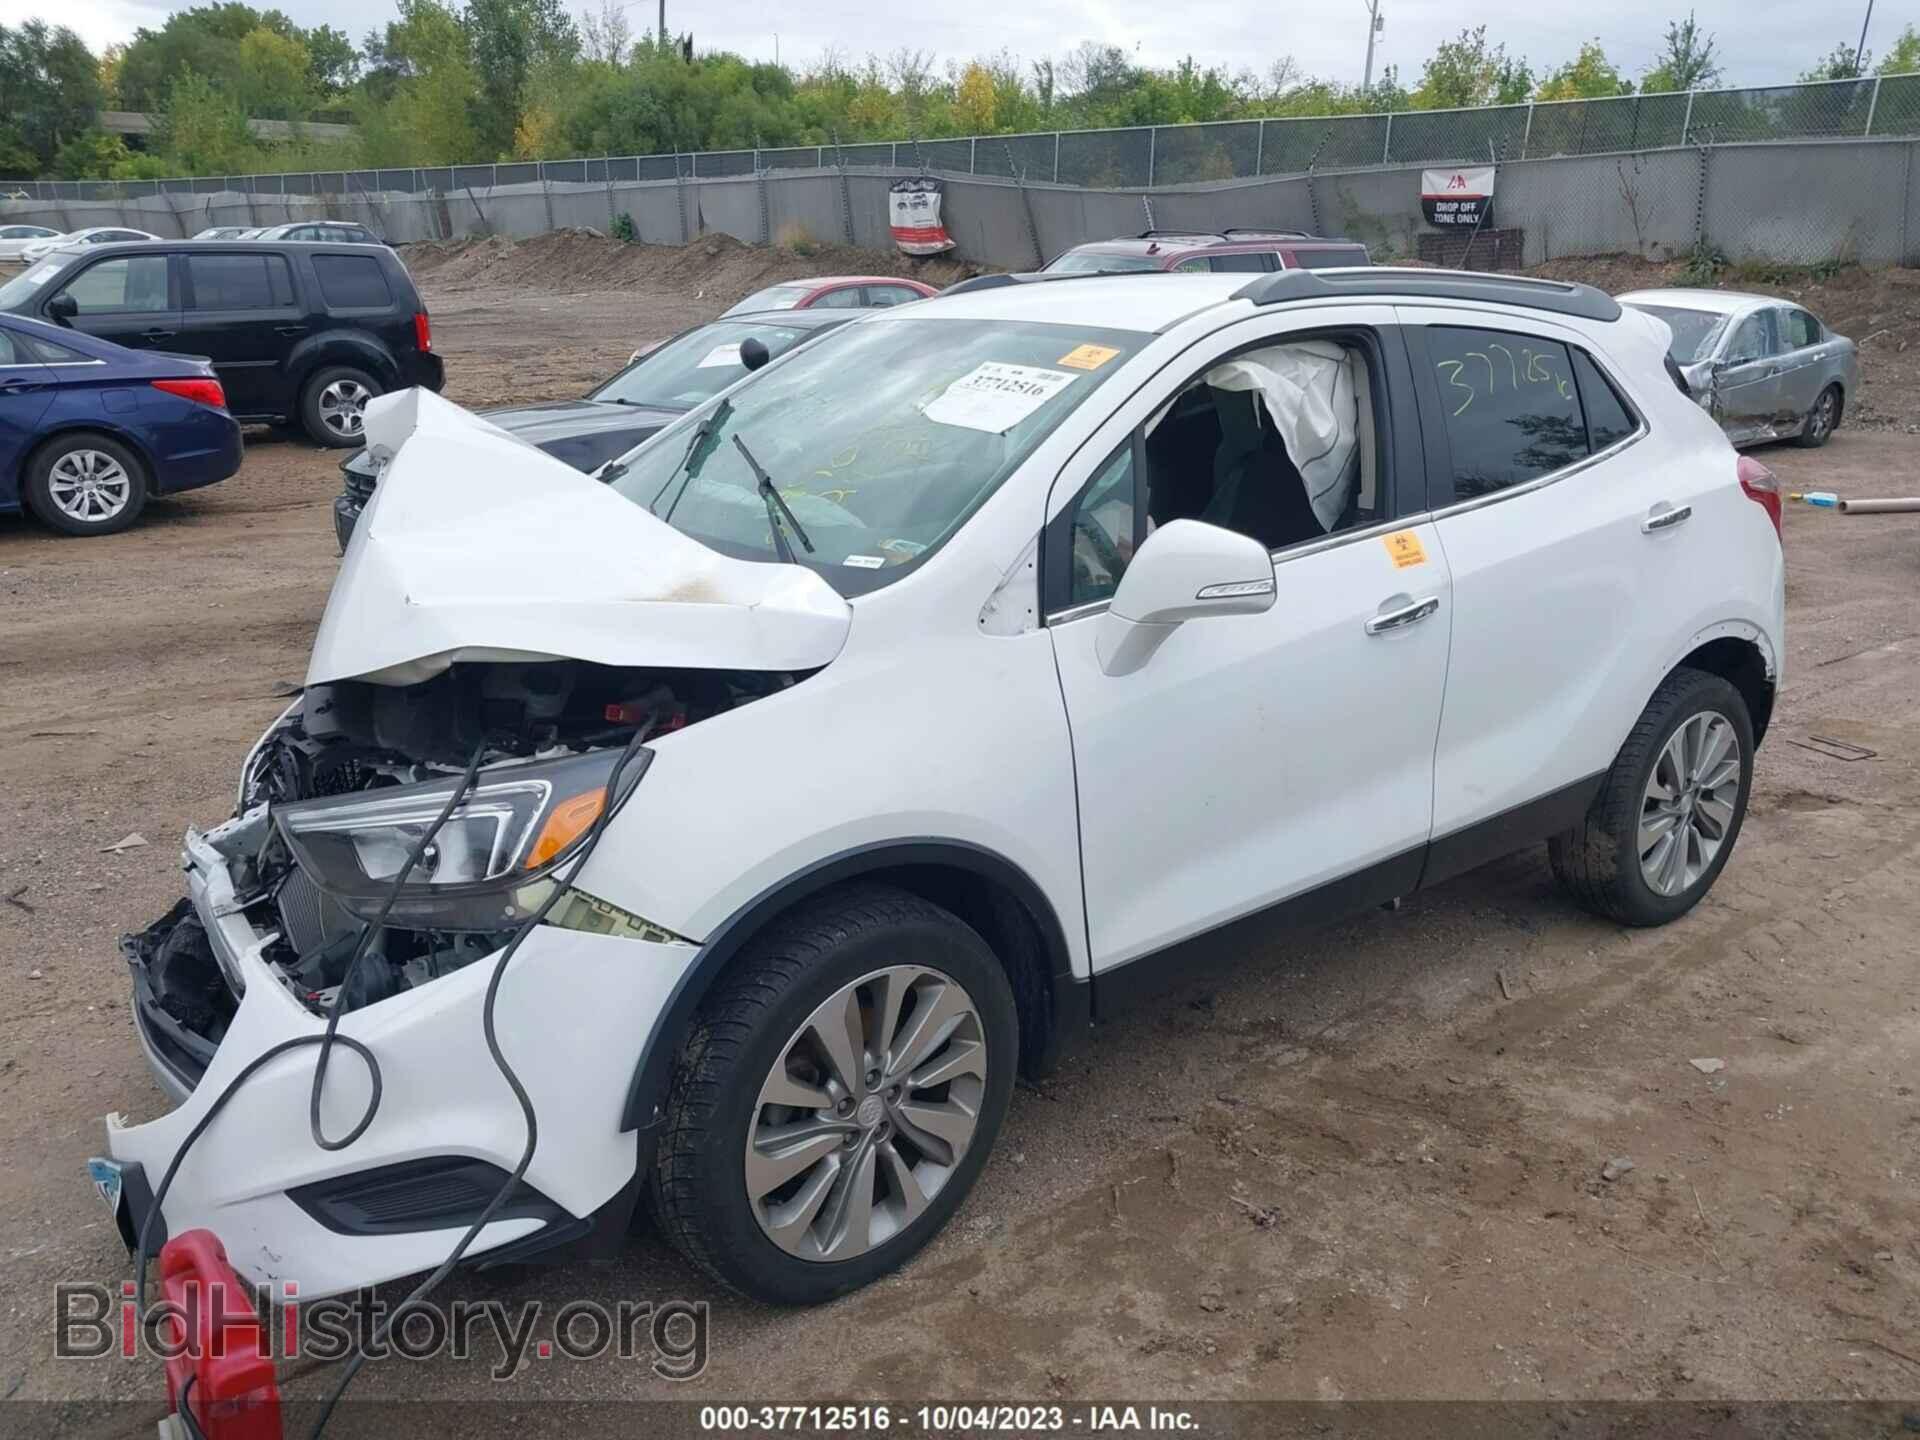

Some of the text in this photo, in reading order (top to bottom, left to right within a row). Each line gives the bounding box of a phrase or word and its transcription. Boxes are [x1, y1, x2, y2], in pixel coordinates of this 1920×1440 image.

[1436, 202, 1477, 212] DROP OFF
[1434, 213, 1480, 223] ZONE ONLY
